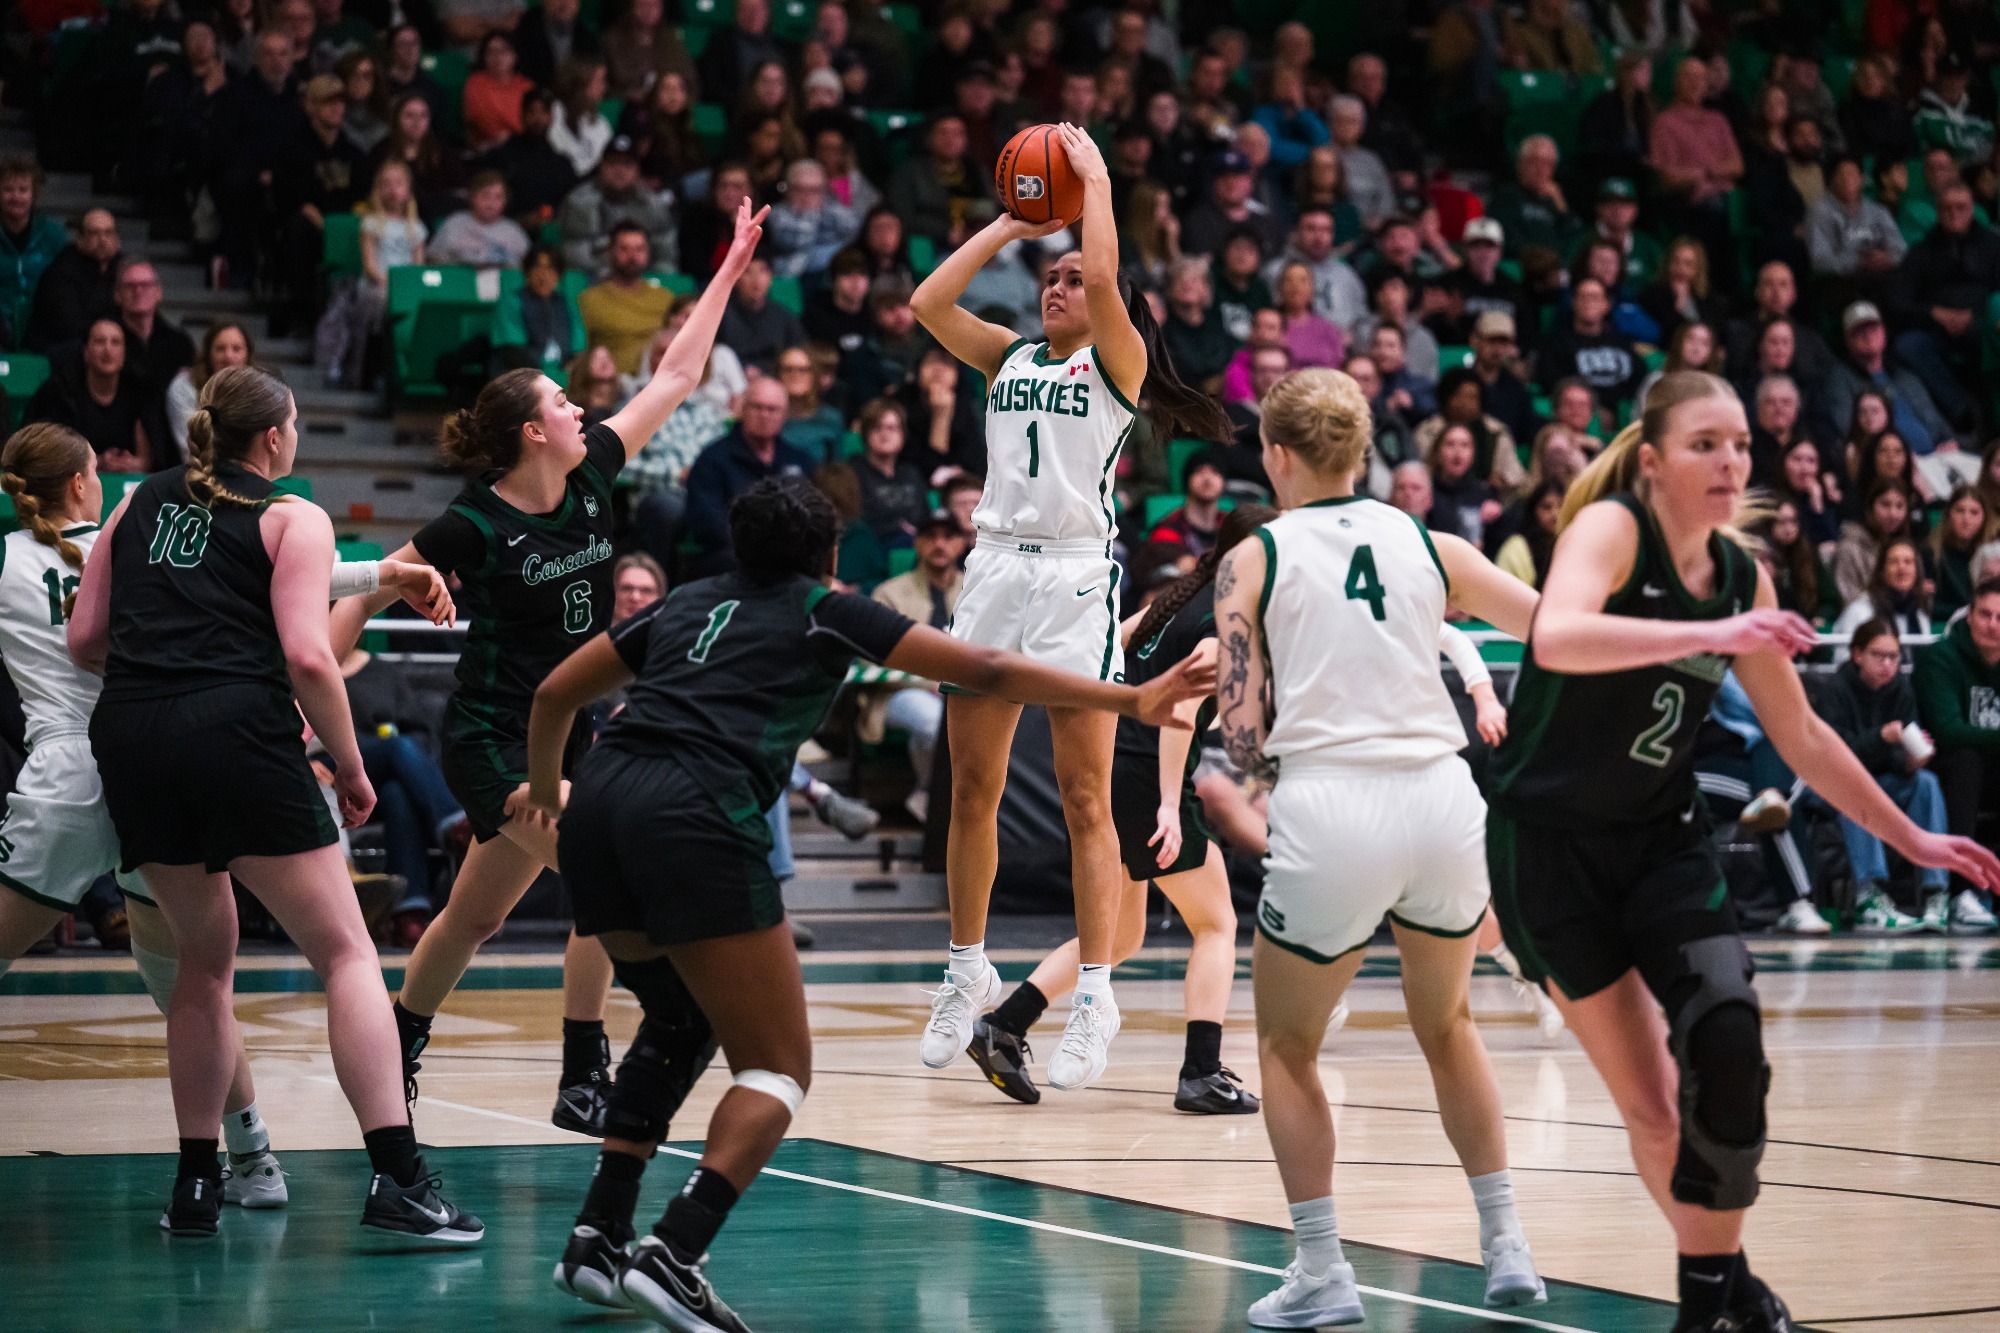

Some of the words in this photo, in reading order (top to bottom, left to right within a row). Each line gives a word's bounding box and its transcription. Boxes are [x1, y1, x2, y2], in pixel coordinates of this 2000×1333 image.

[991, 378, 1090, 418] HUSKIES
[1026, 420, 1040, 478] 1
[149, 503, 213, 568] 10
[522, 533, 613, 586] Cascades
[1018, 543, 1043, 554] SASK
[42, 566, 81, 626] 1
[562, 579, 593, 634] 6
[1344, 544, 1387, 622] 4
[687, 599, 741, 664] 1
[1629, 681, 1686, 768] 2
